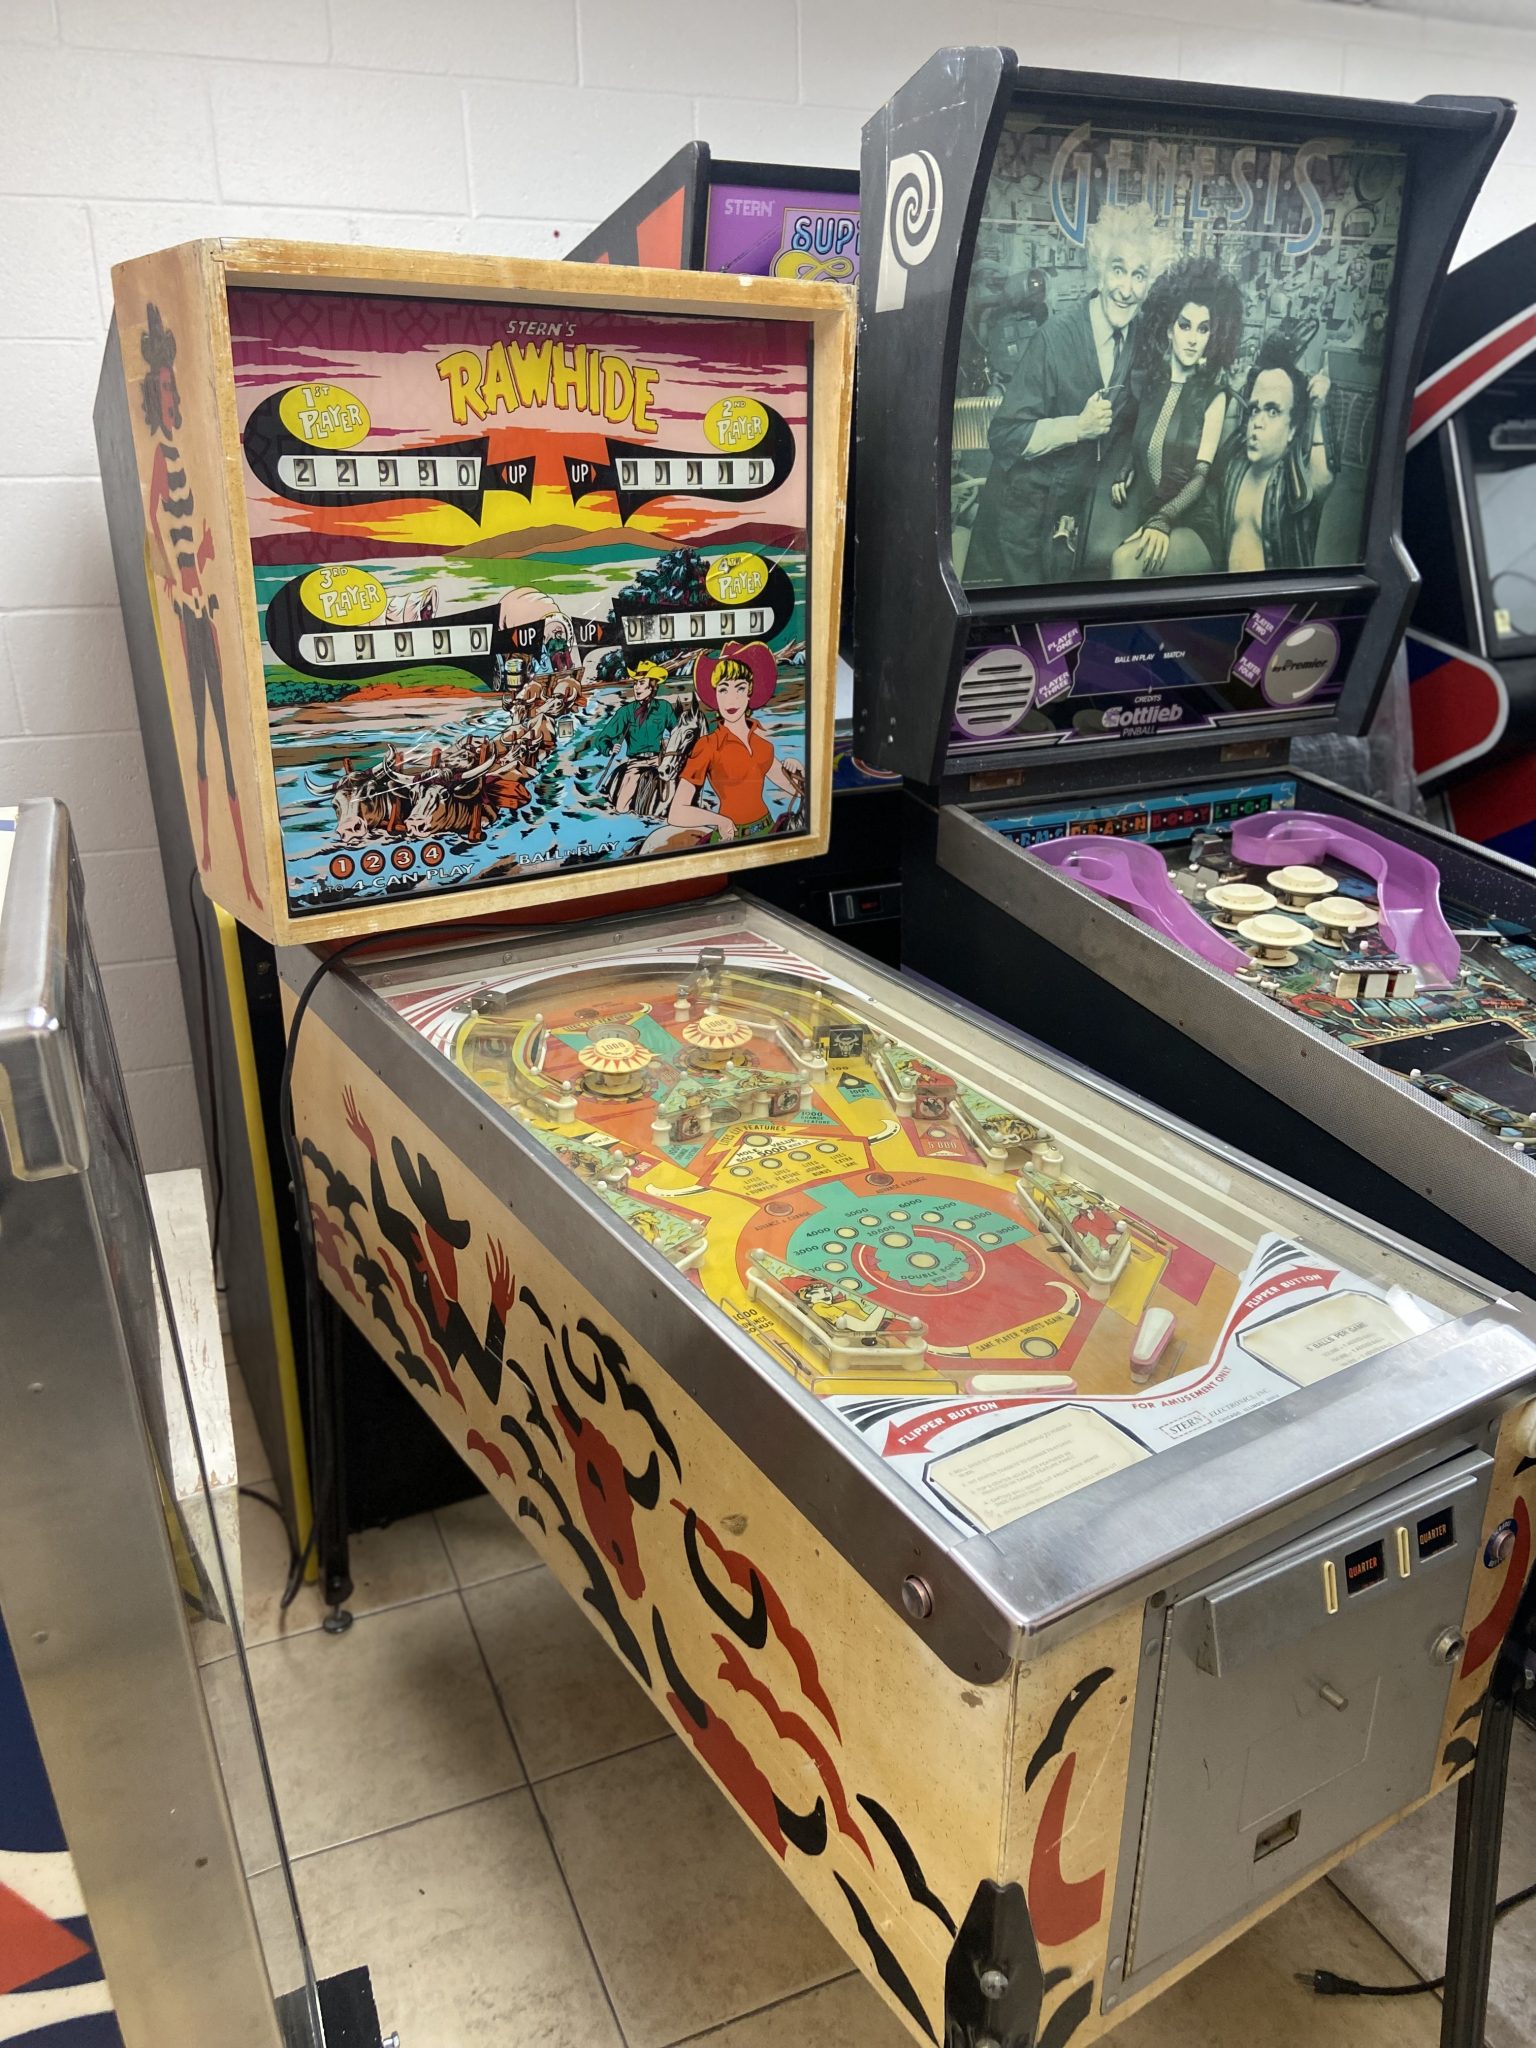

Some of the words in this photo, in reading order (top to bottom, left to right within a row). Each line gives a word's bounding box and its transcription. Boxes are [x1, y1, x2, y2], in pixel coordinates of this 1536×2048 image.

[724, 199, 773, 217] STERN
[791, 216, 860, 256] SUP
[506, 320, 577, 337] STERN'S
[436, 340, 660, 434] RAWHIDE
[298, 403, 363, 439] PLAYER
[716, 415, 762, 445] PLAYER
[508, 464, 527, 484] UP
[571, 464, 589, 482] UP
[718, 571, 761, 600] PLAYER
[319, 584, 381, 619] PLAYER
[1252, 612, 1274, 633] PLAYER
[1252, 622, 1267, 636] TWO
[519, 627, 536, 646] UP
[579, 624, 597, 642] UP
[1047, 628, 1079, 651] PLAYER
[1056, 638, 1074, 652] ONE
[1139, 653, 1155, 661] PLAY
[1163, 651, 1186, 659] MATCH
[1238, 665, 1254, 680] FOUR
[1239, 656, 1261, 675] PLAYER
[1039, 671, 1070, 695] PLAYER
[1043, 680, 1069, 698] THREE
[1134, 695, 1162, 703] CREDITS
[1102, 704, 1183, 727] Gottlieb
[1122, 726, 1156, 737] PINBALL
[366, 855, 380, 868] 2
[397, 851, 410, 865] 3
[426, 847, 438, 859] 4
[519, 850, 563, 865] BALL
[577, 841, 620, 856] PLAY
[338, 859, 346, 872] 1
[311, 885, 319, 897] 1
[352, 880, 365, 890] 4
[372, 872, 418, 888] CAN
[427, 863, 475, 880] PLAY
[601, 1041, 626, 1051] 1000
[743, 1124, 786, 1132] FEATURES
[756, 1145, 788, 1156] 5000
[771, 1138, 795, 1147] VALUE
[737, 1148, 758, 1157] HOLE
[933, 1201, 957, 1211] 7000
[806, 1227, 831, 1238] 4000
[793, 1245, 819, 1256] 3000
[901, 1271, 937, 1280] DOUBLE
[941, 1256, 962, 1273] BONUS
[1245, 1285, 1280, 1310] FLIPPER
[1280, 1273, 1322, 1288] BUTTON
[975, 1341, 994, 1352] SAME
[995, 1332, 1020, 1345] PLAYER
[1020, 1322, 1045, 1335] SHOOTS
[1045, 1315, 1064, 1326] AGAIN
[1312, 1336, 1335, 1349] BALLS
[1132, 1402, 1155, 1410] FOR
[1161, 1382, 1219, 1408] AMUSEMENT
[1215, 1366, 1232, 1383] ONLY
[898, 1417, 945, 1446] FLIPPER
[947, 1401, 999, 1421] BUTTON
[1169, 1415, 1204, 1435] STERN
[1419, 1523, 1447, 1545] QUARTER
[1348, 1556, 1377, 1579] QUARTER
